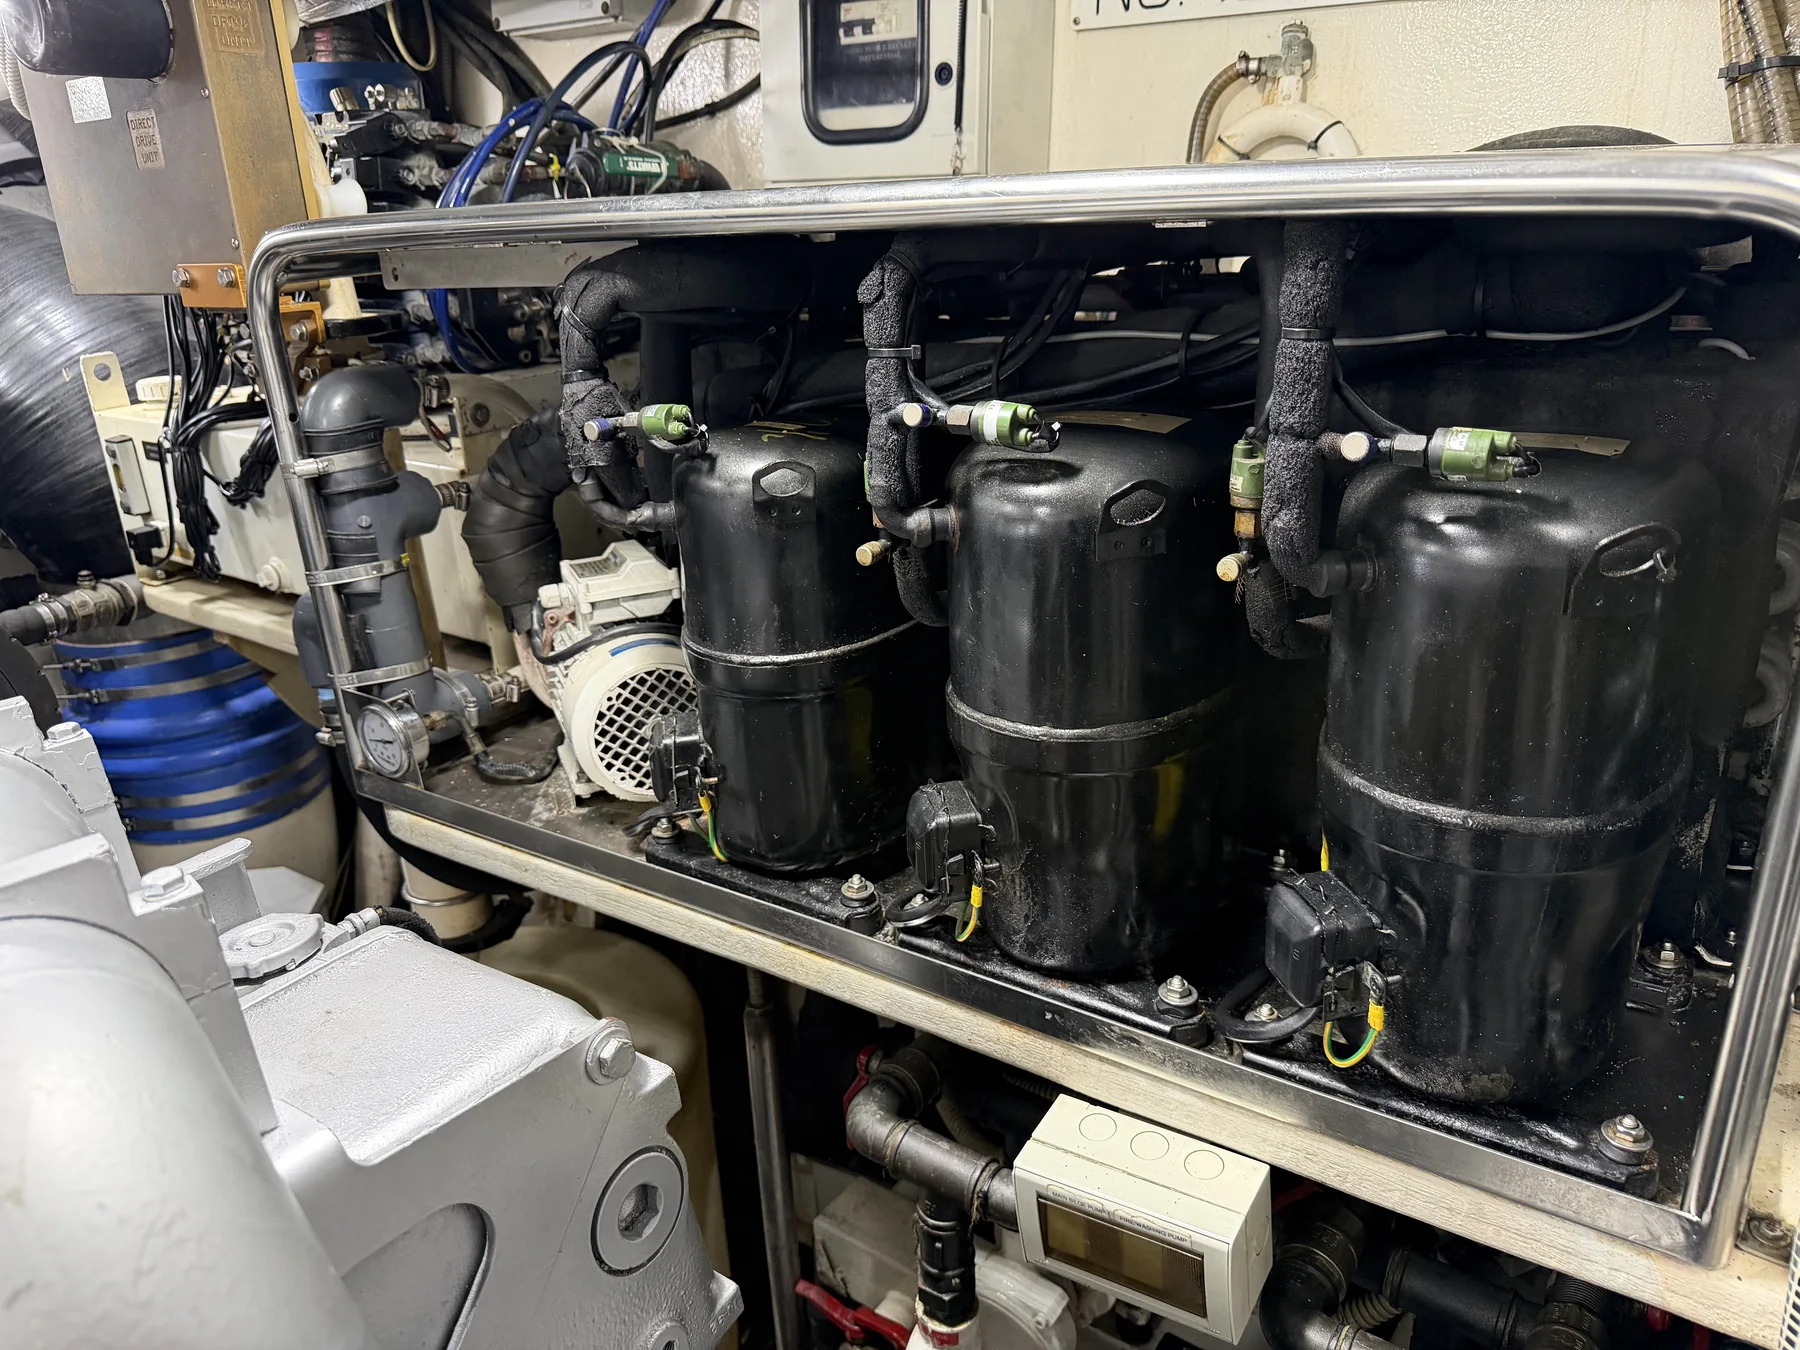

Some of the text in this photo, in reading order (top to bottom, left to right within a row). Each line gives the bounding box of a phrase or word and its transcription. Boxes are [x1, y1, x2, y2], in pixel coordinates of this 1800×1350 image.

[130, 116, 155, 130] DIRECT
[135, 134, 157, 147] DRIVE
[141, 151, 158, 163] UNIT
[1051, 1191, 1068, 1201] MAIN
[1087, 1203, 1107, 1214] PUMP
[1167, 1231, 1188, 1243] PUMP
